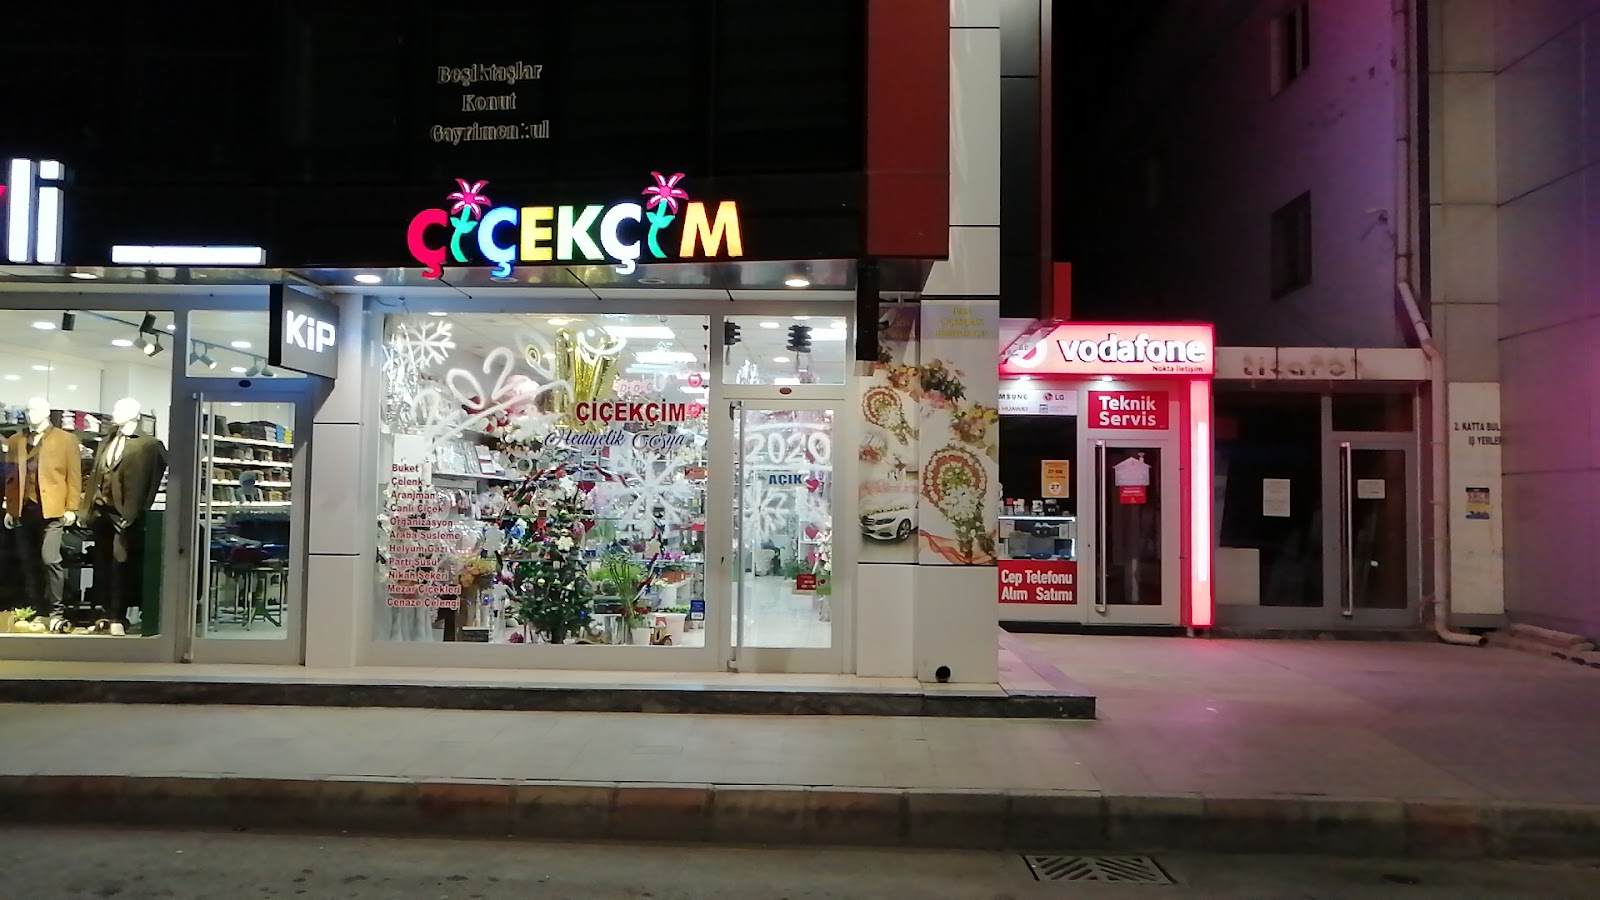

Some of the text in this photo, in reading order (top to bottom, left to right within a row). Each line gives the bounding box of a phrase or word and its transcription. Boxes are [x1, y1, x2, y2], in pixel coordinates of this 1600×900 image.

[437, 61, 543, 87] Beşiktaşlar
[461, 91, 517, 112] Konut
[1056, 332, 1207, 363] vodafone
[1152, 364, 1174, 373] Nokta
[1098, 395, 1157, 411] Teknik
[575, 397, 686, 427] ÇİÇEKÇİM
[1098, 411, 1157, 426] Servis
[1462, 422, 1485, 431] KATTA
[544, 428, 686, 454] Hediyelik Eşya
[743, 430, 832, 465] 2020
[391, 463, 419, 473] Buket
[391, 477, 423, 487] Çelenk
[768, 474, 803, 486] AÇIK
[391, 490, 436, 501] Aranjman
[390, 503, 443, 514] Canlı Çiçek
[390, 516, 454, 527] Organizasyon
[389, 530, 417, 539] Araba
[389, 544, 448, 554] Helyum Gazı
[388, 571, 449, 581] Nikah Şekeri
[1001, 569, 1073, 587] Cep Telefonu
[387, 584, 461, 595] Mezar Çiçekleri
[1001, 586, 1073, 602] Alım Satımı
[387, 598, 461, 610] Cenaze Çelengi
